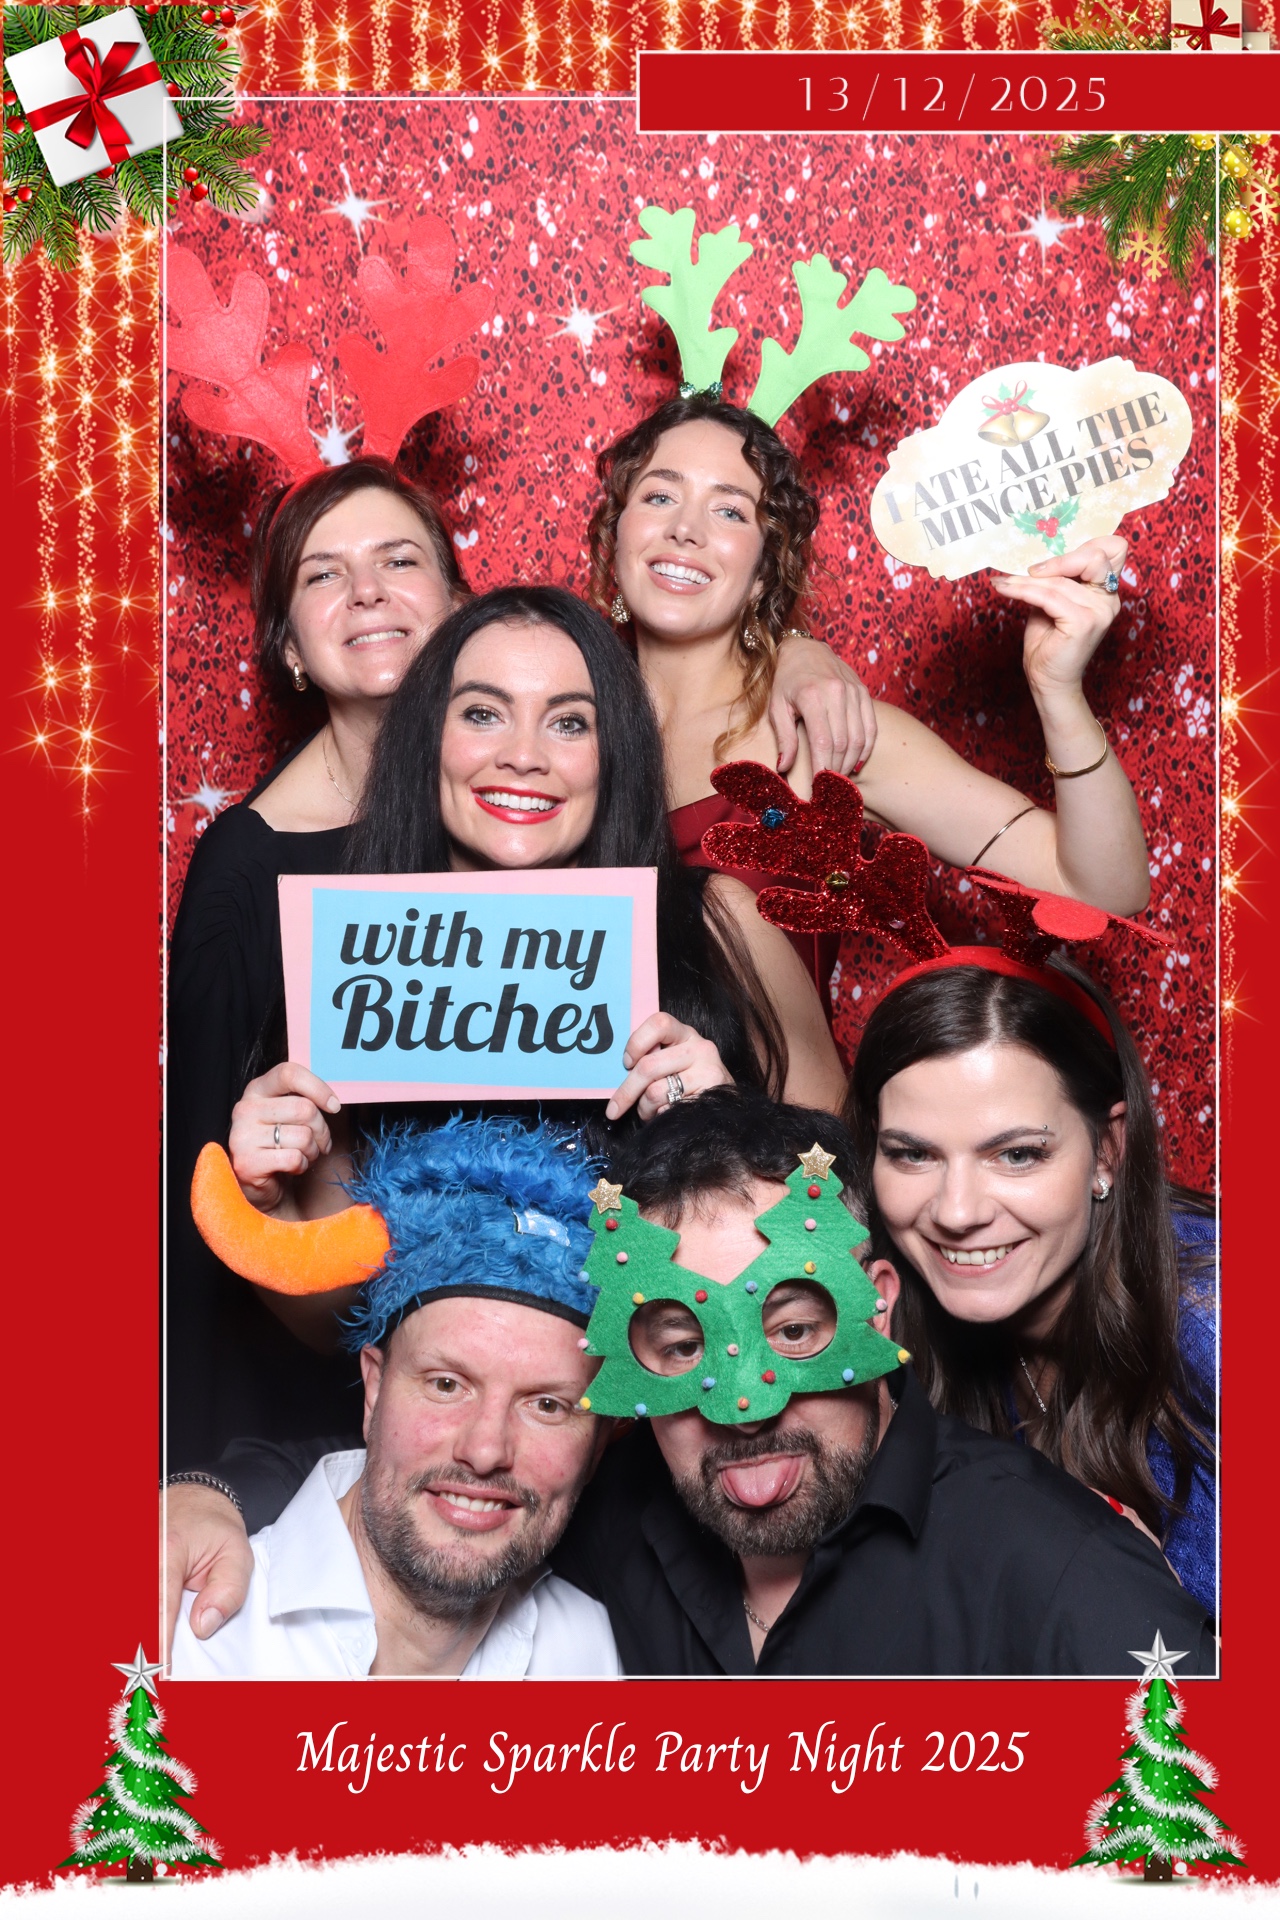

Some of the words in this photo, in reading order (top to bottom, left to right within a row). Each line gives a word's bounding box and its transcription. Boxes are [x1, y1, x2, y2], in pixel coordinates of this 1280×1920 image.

[883, 491, 905, 525] I
[913, 459, 990, 517] ATE
[1000, 429, 1076, 484] ALL
[1077, 391, 1168, 449] THE
[921, 473, 1056, 550] MINCE
[1058, 436, 1154, 496] PIES
[340, 908, 484, 968] with
[500, 927, 607, 990] my
[332, 974, 614, 1055] Bitches
